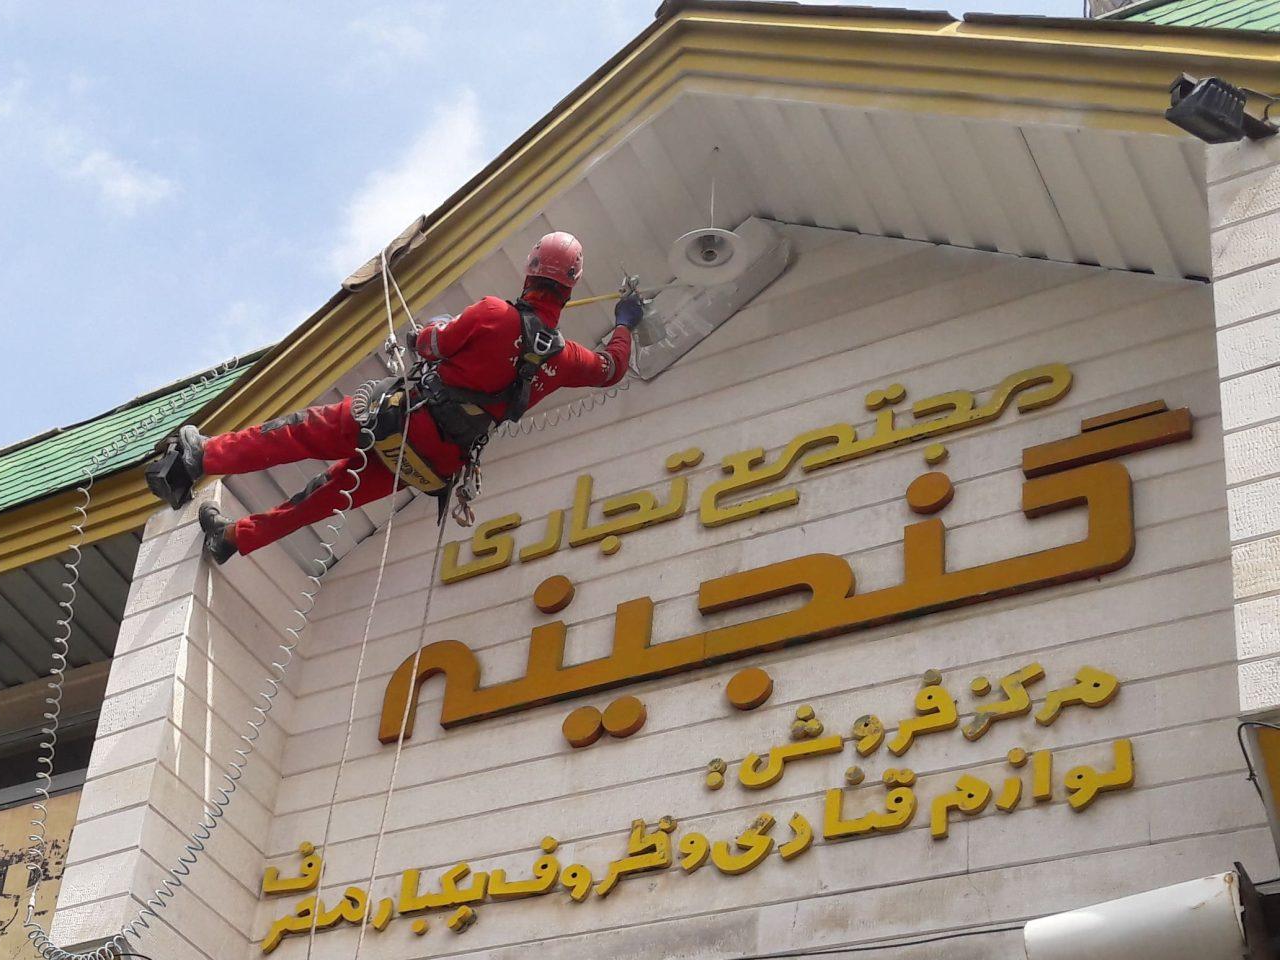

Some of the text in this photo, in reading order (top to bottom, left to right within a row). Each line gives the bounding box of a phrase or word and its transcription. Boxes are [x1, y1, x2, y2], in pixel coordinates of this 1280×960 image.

[441, 363, 1074, 585] مجتمع تجاری
[378, 400, 1194, 748] گنجینه
[961, 662, 1119, 741] مرکز
[931, 738, 1135, 840] لوازم
